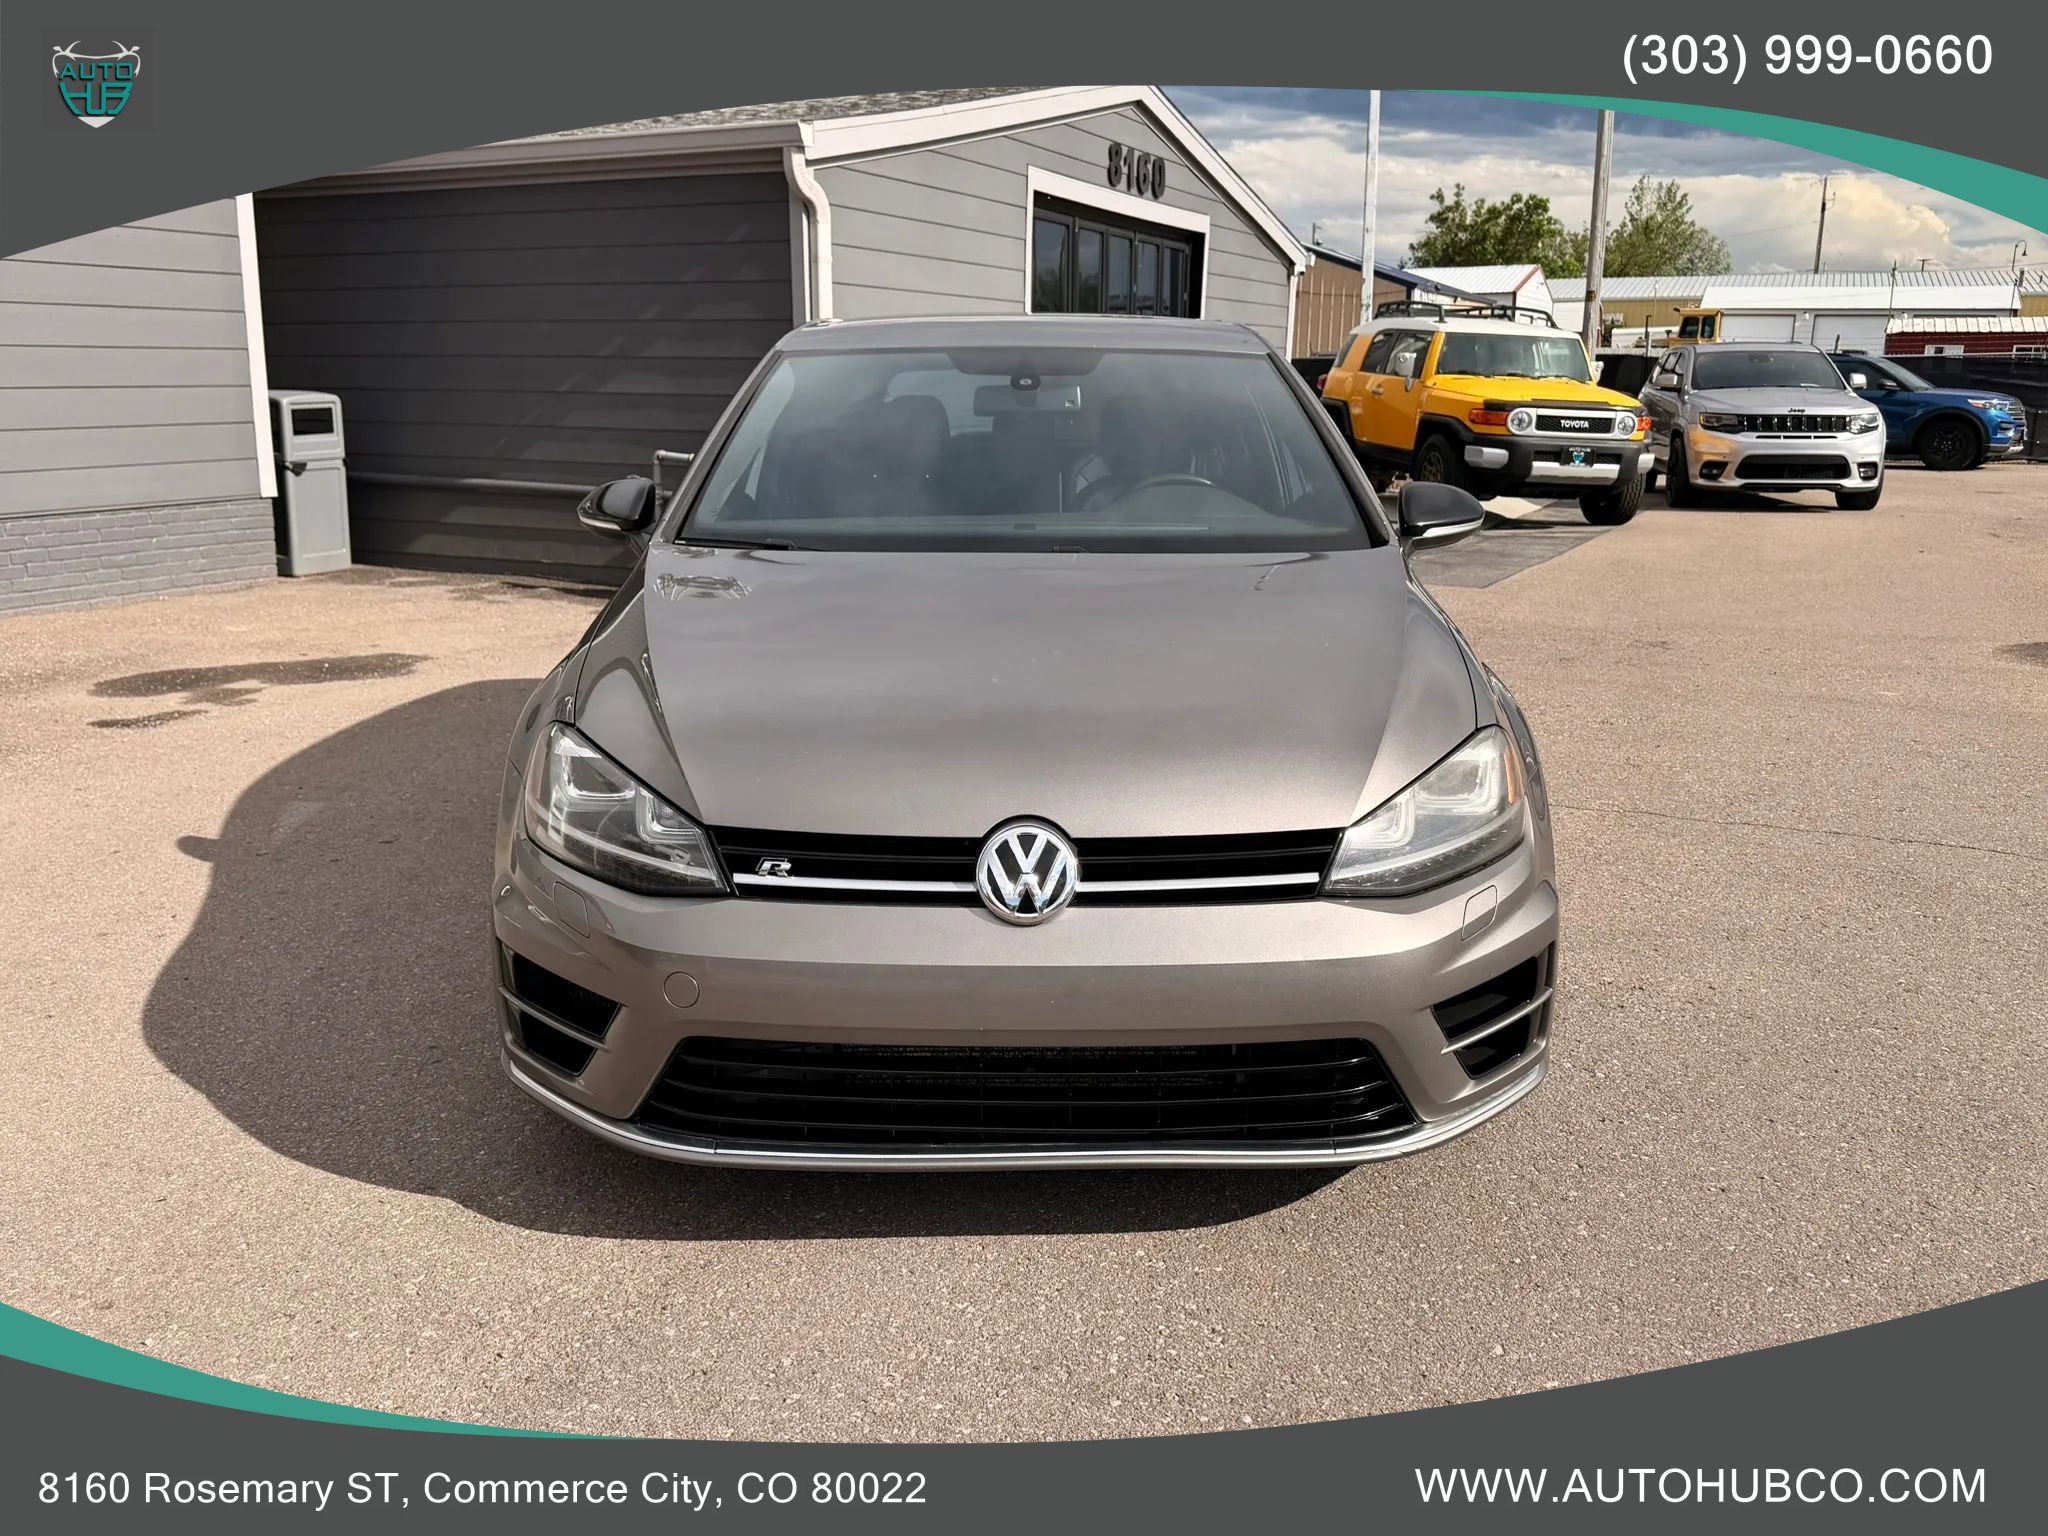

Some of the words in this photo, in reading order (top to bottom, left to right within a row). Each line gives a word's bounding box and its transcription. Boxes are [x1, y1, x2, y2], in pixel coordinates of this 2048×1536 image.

[1107, 143, 1166, 200] 8160
[1560, 419, 1589, 428] TOYOTA
[756, 857, 792, 878] R
[981, 829, 1071, 919] VW
